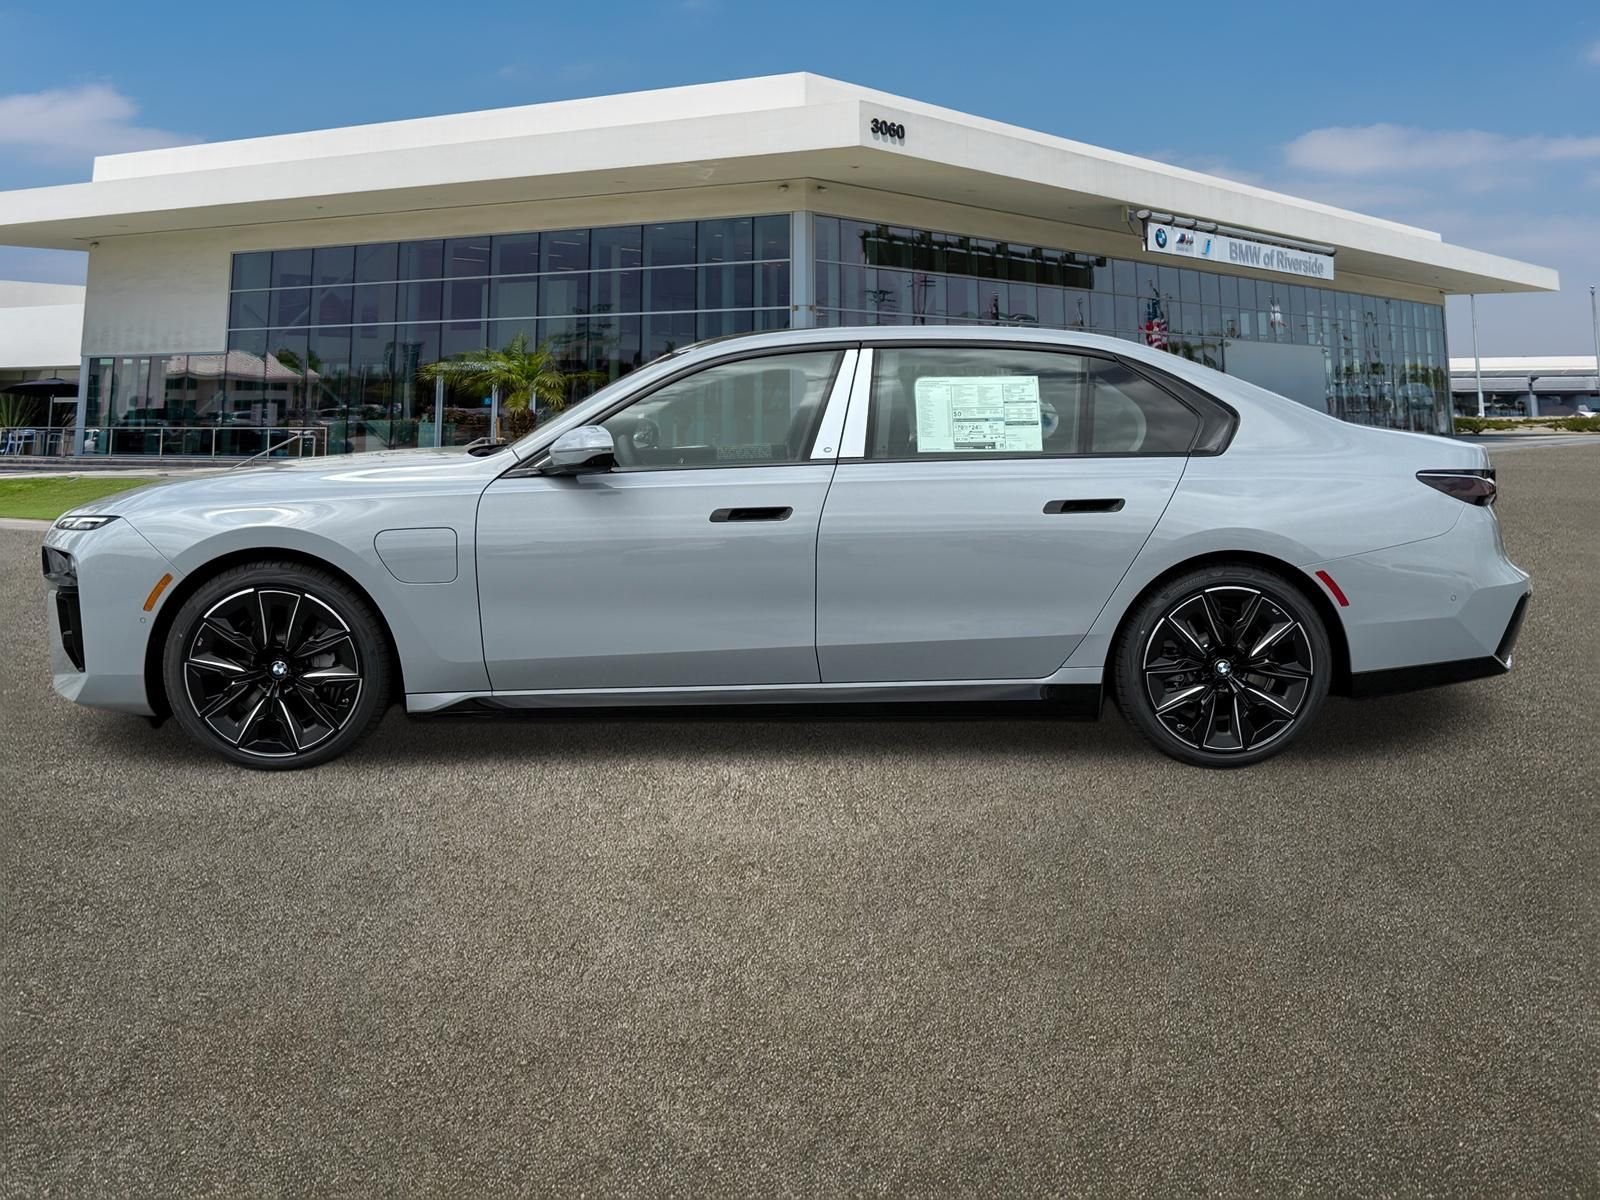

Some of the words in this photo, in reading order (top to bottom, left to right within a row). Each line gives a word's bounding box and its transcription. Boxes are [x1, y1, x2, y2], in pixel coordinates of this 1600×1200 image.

[871, 118, 905, 139] 3060
[1229, 241, 1261, 265] BMW
[1263, 250, 1275, 266] of
[1277, 250, 1325, 275] Riverside
